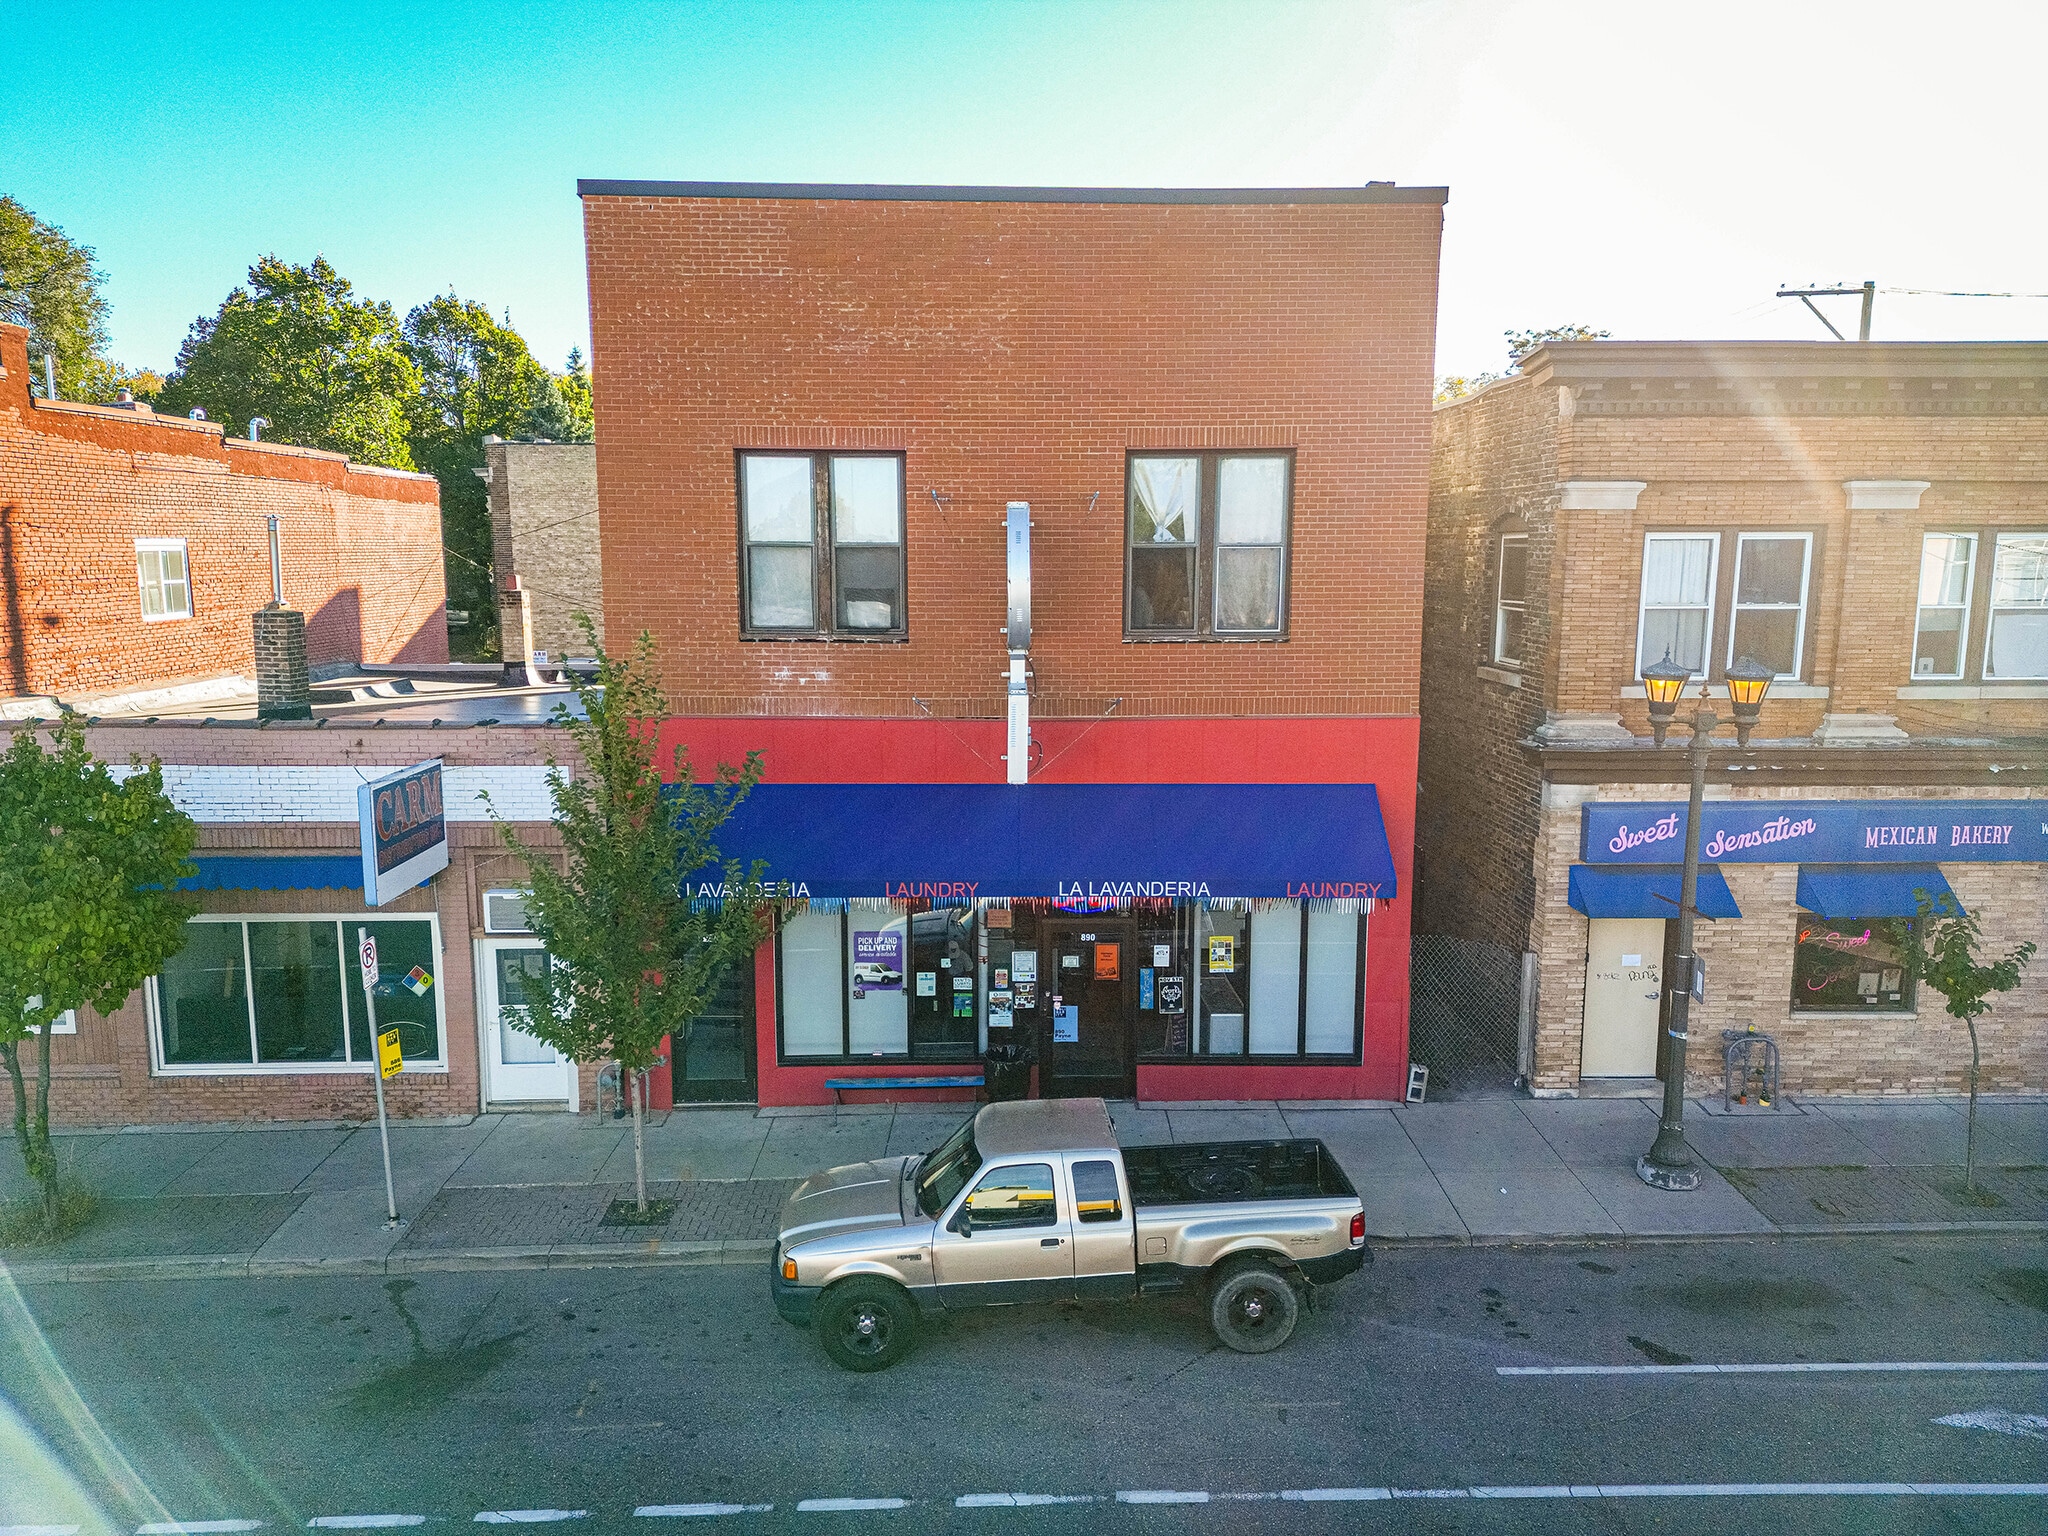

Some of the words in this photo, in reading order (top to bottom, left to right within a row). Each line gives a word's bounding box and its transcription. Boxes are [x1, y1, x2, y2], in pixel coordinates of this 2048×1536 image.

[376, 770, 443, 841] CARM
[1609, 813, 1679, 853] Sweet
[1706, 816, 1816, 858] Sensation
[1865, 826, 1938, 848] MEXICAN
[1951, 825, 2013, 847] BAKERY
[886, 882, 979, 897] LAUNDRY
[1059, 881, 1083, 896] LA
[1089, 881, 1211, 896] LAVANDERIA
[1287, 882, 1382, 898] LAUNDRY
[858, 936, 873, 945] PICK
[874, 936, 883, 945] UP
[884, 936, 898, 945] AND
[1080, 933, 1096, 942] 890
[858, 944, 897, 952] DELIVERY
[422, 976, 429, 985] 0
[384, 1063, 402, 1073] Payne
